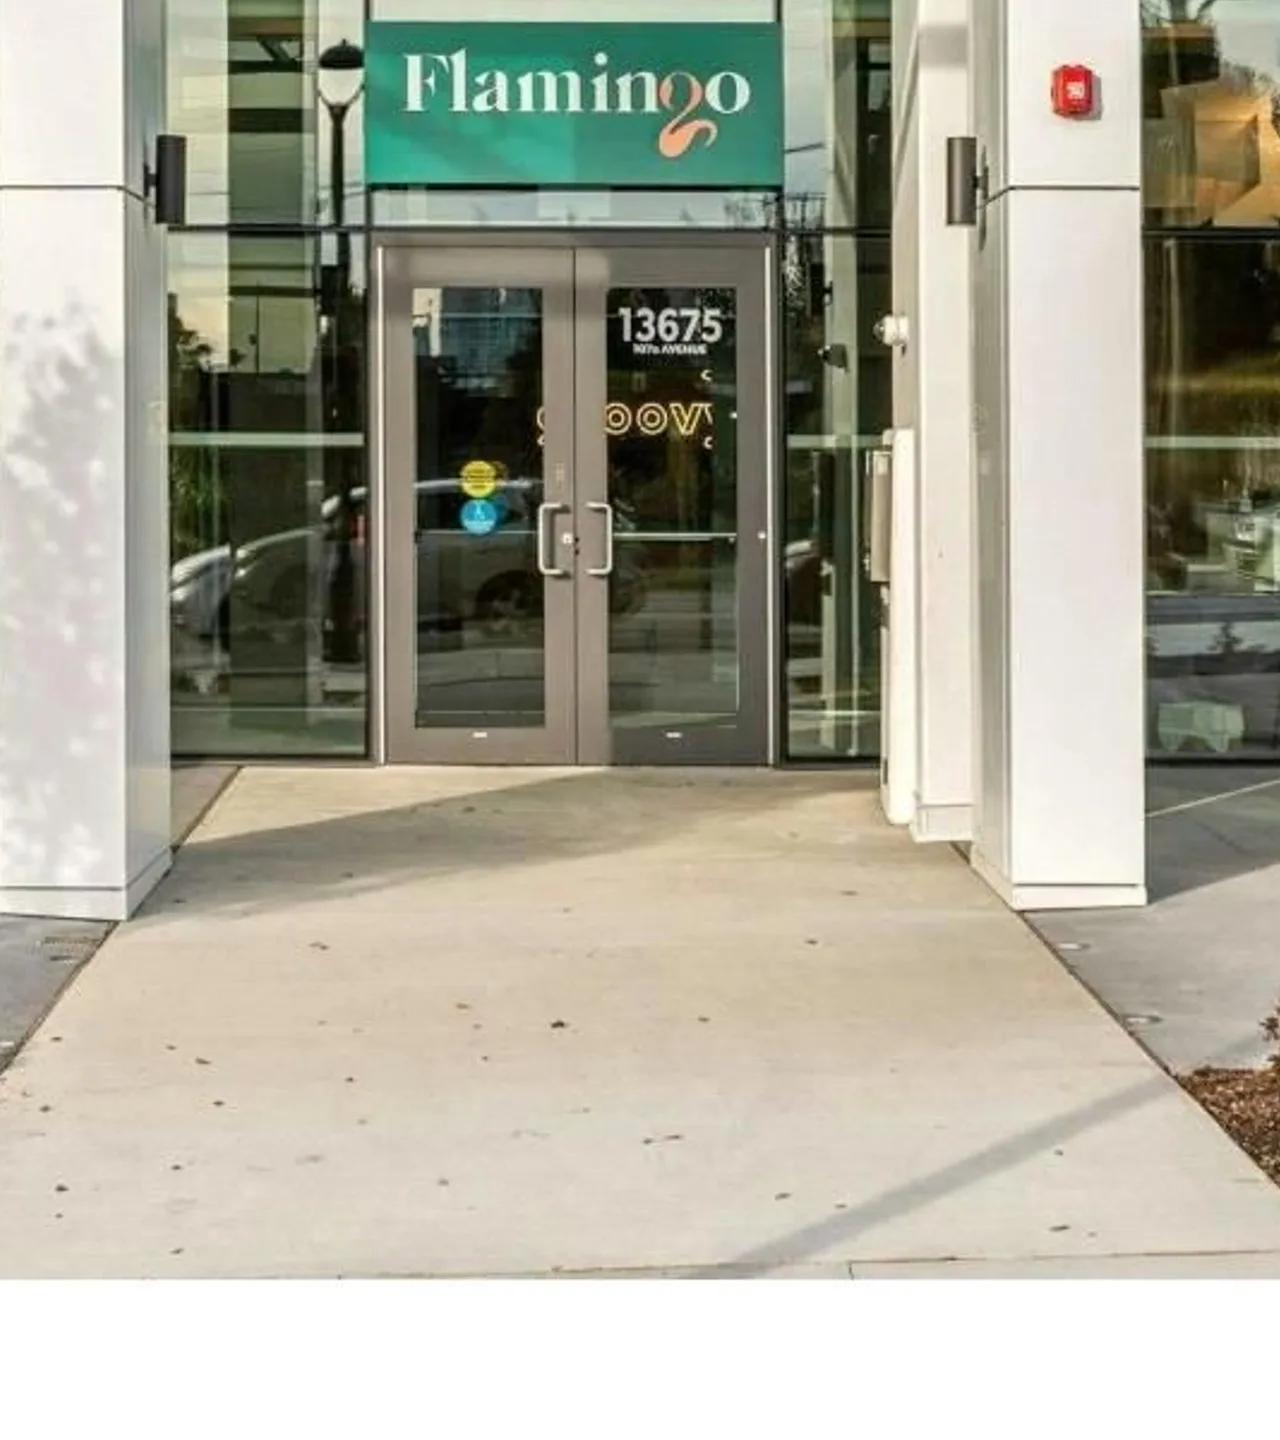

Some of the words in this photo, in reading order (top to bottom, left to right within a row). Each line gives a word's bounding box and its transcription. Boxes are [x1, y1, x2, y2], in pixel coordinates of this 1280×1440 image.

[403, 47, 751, 159] Flamingo
[618, 306, 723, 344] 13675
[661, 343, 707, 355] AVENUE
